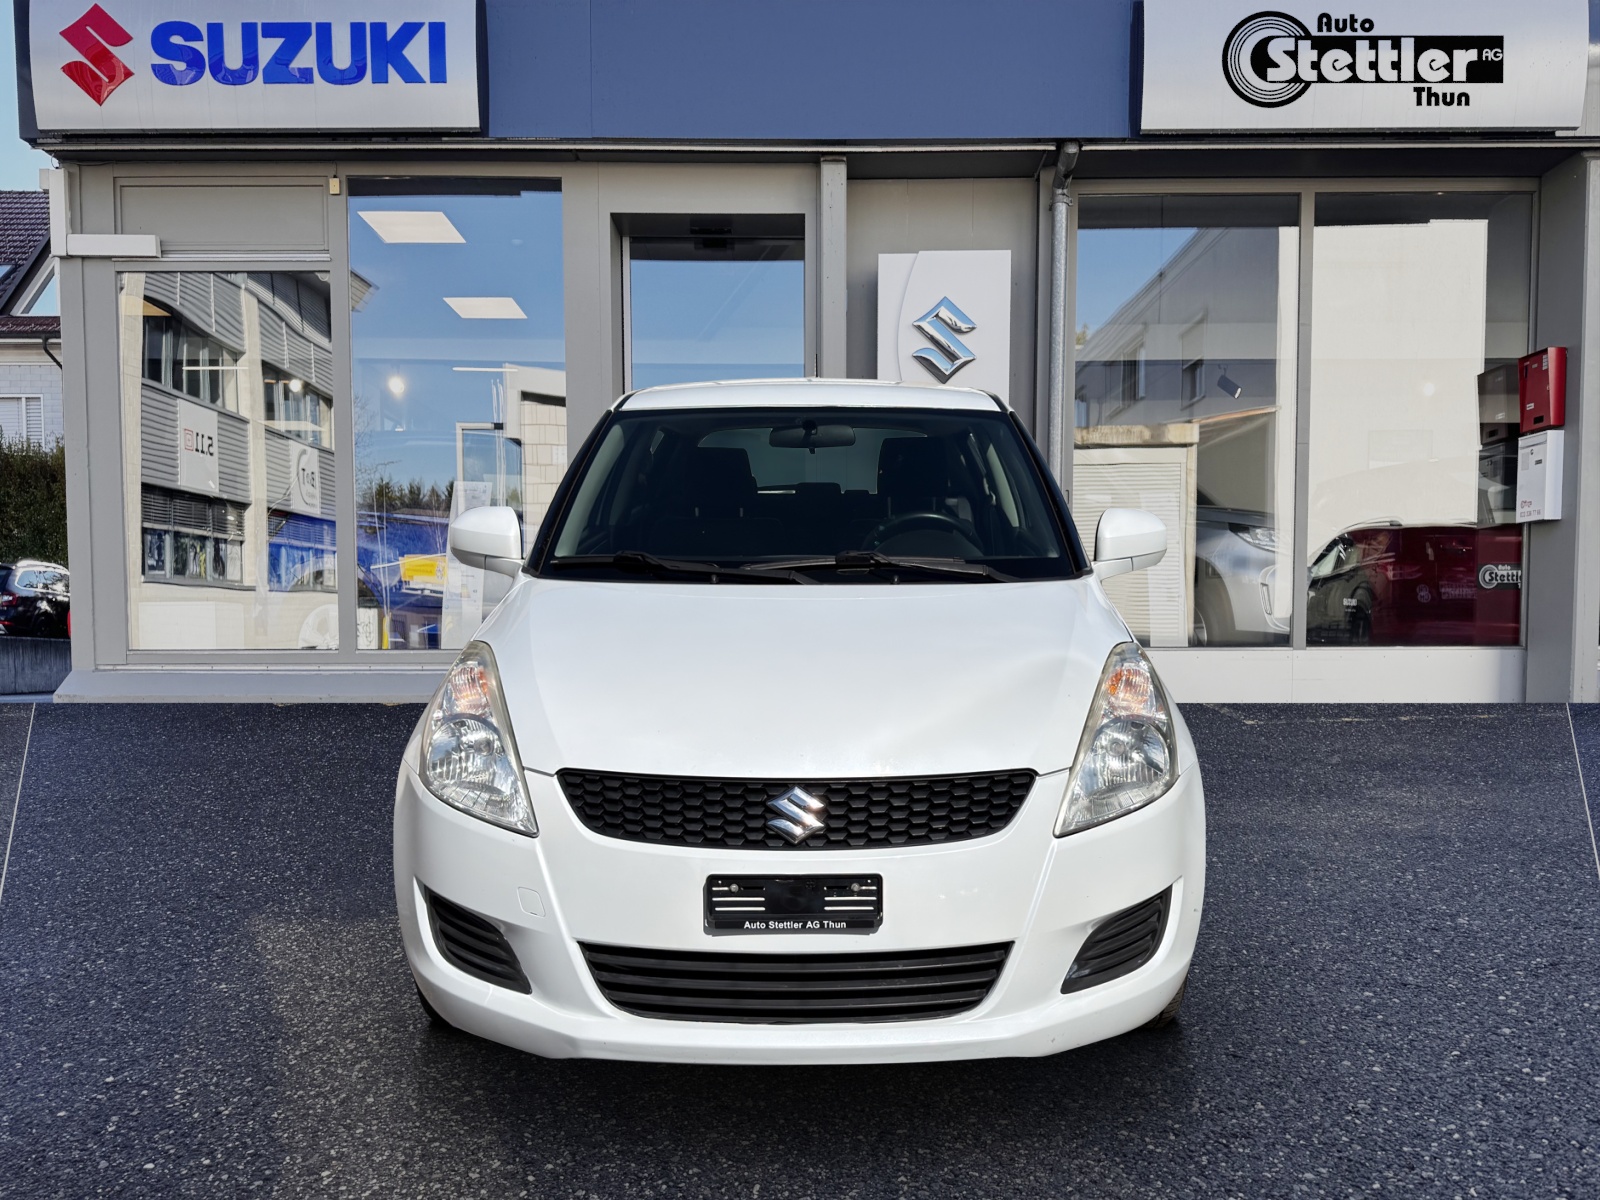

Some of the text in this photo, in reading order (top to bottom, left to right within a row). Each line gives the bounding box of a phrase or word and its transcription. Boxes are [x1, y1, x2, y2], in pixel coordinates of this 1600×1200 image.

[1317, 12, 1374, 33] Auto
[150, 20, 448, 86] SUZUKI
[1266, 36, 1503, 83] Stettler AG
[1413, 86, 1470, 107] Thun
[743, 920, 847, 929] Auto Stettler AG Thun
